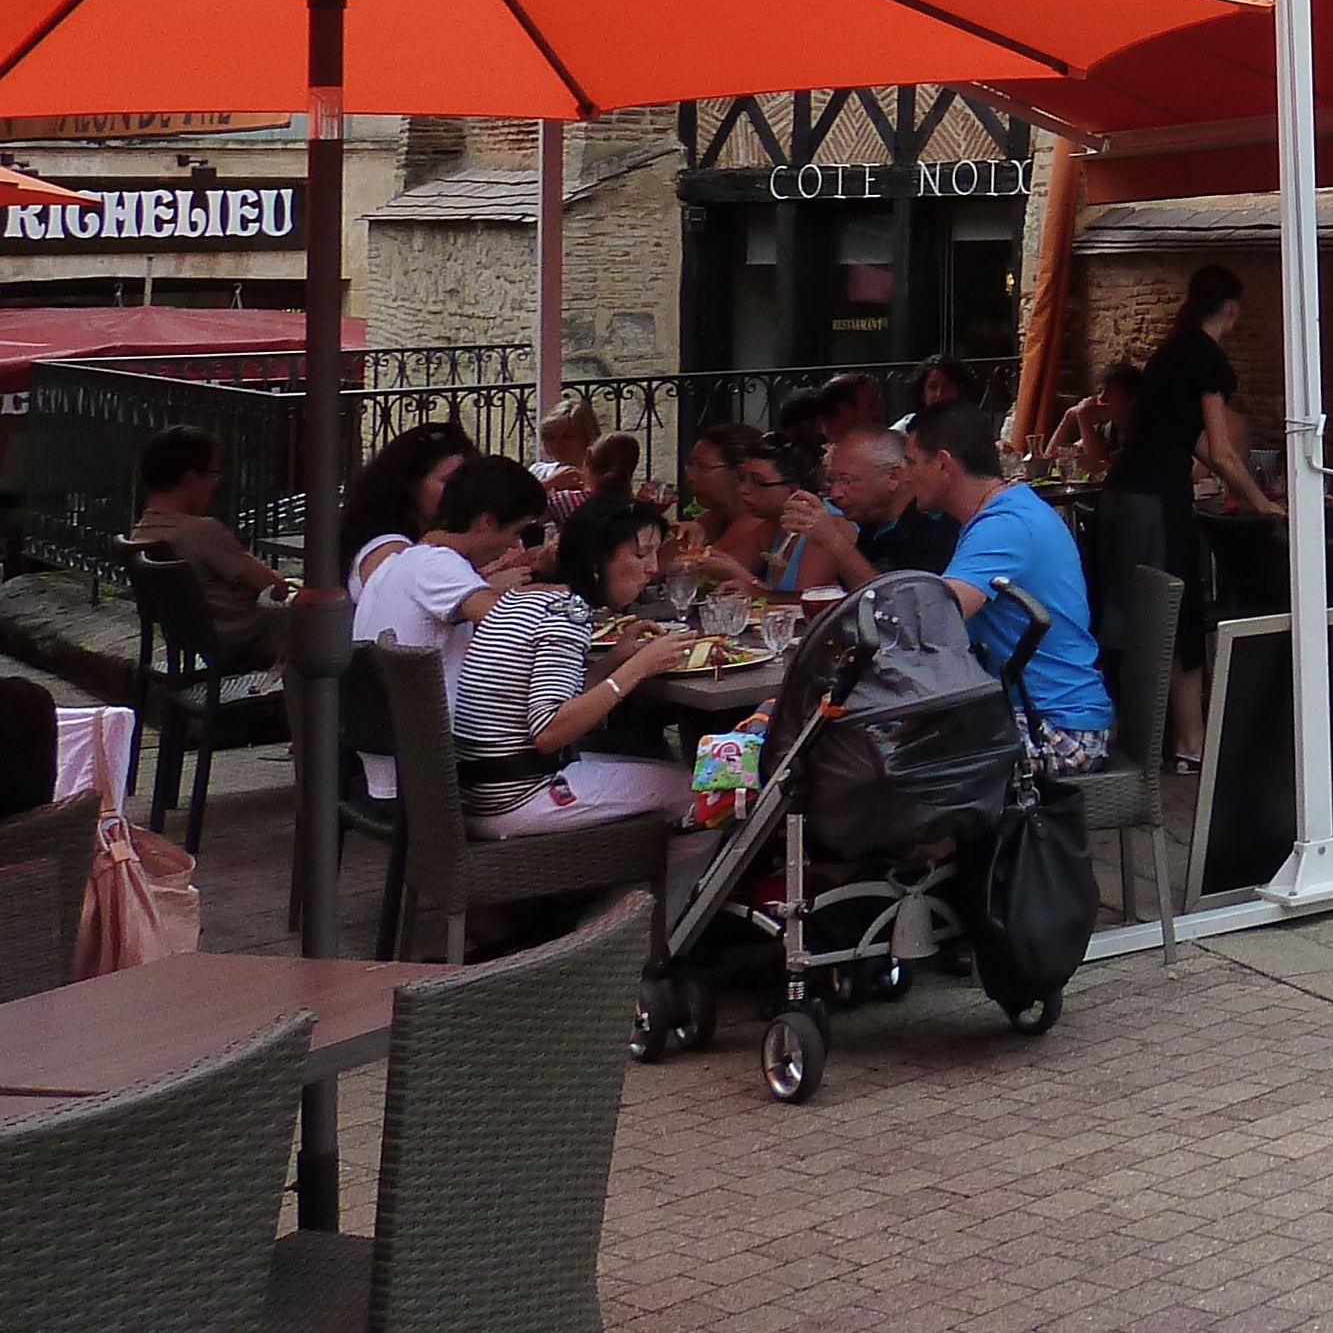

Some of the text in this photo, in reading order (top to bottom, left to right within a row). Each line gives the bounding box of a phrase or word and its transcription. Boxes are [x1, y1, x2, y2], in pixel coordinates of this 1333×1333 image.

[769, 158, 1032, 201] COTE NOIX
[3, 189, 294, 240] RICHELIEU
